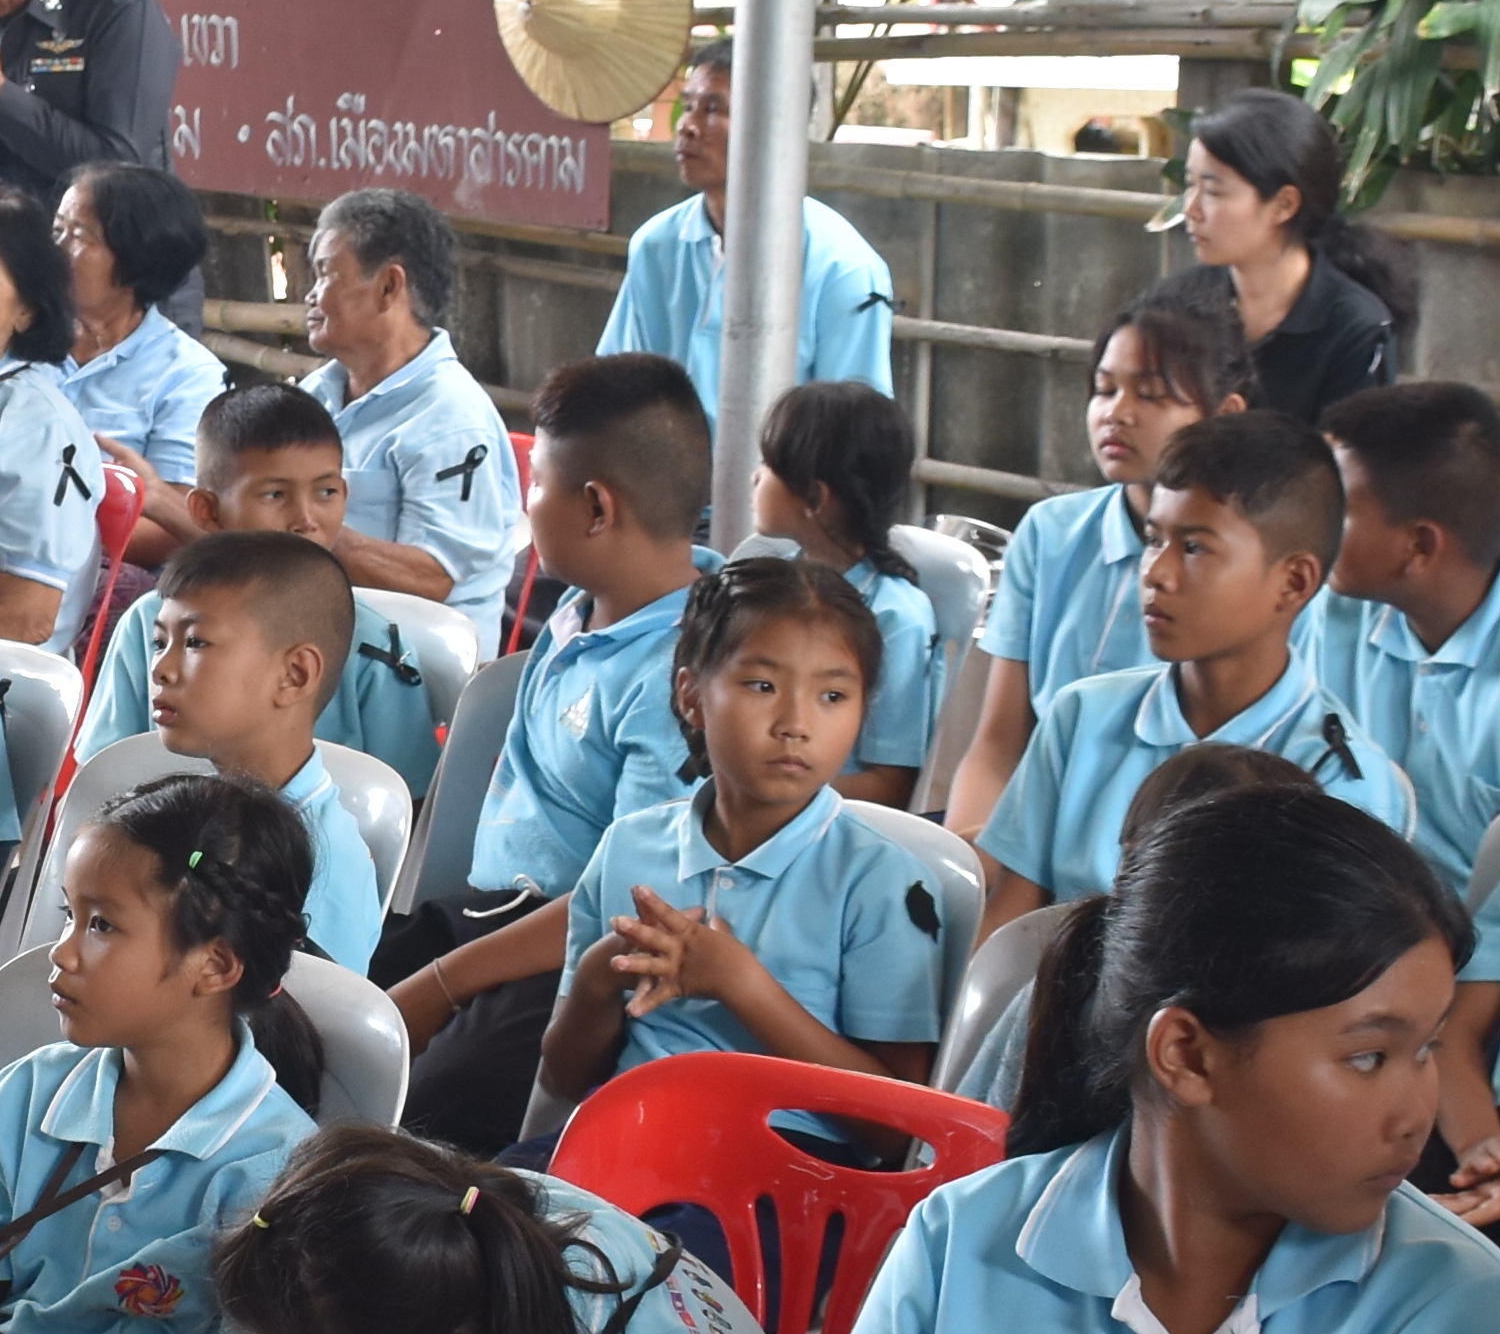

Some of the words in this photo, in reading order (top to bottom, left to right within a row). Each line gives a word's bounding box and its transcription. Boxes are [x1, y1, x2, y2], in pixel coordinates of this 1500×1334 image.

[265, 93, 587, 194] สภ.เมืองมหาสารคาม
